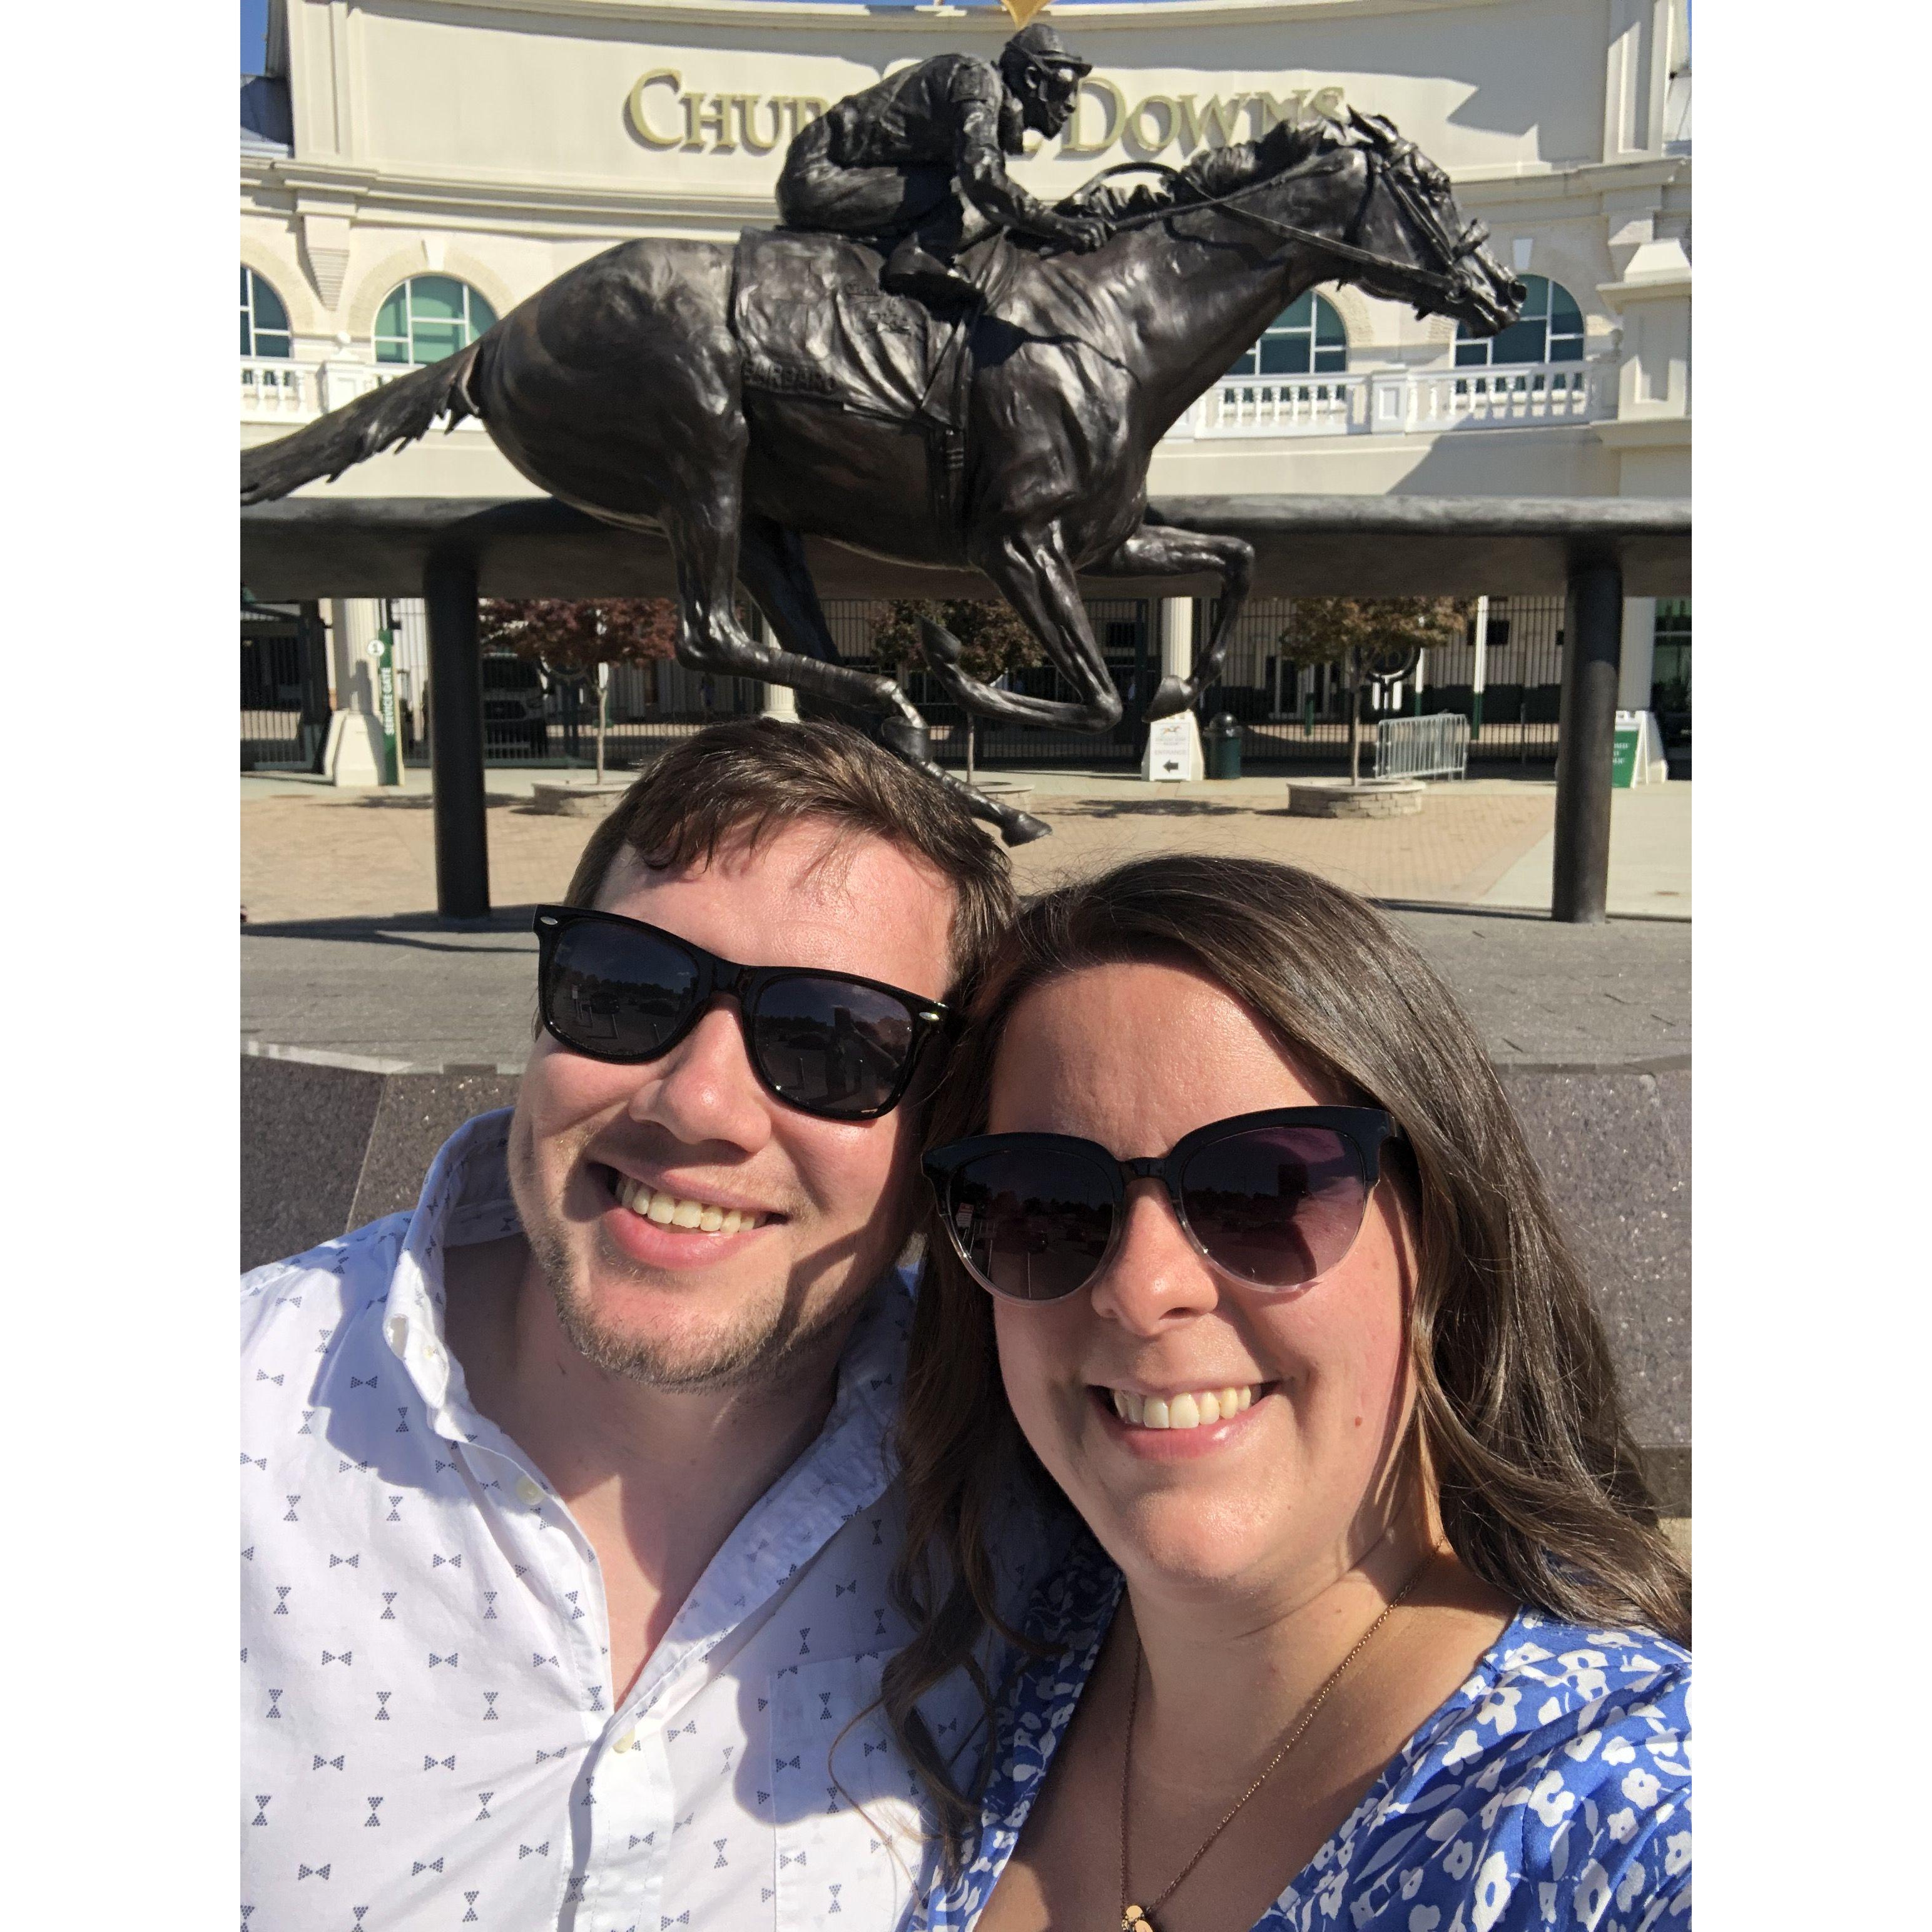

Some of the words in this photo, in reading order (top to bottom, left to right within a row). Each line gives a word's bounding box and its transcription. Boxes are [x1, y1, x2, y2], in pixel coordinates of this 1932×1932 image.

[628, 67, 833, 150] CHUR
[1063, 76, 1346, 151] DOWNS
[372, 643, 379, 654] 1
[381, 668, 392, 693] GATE
[384, 694, 395, 735] SERVICE
